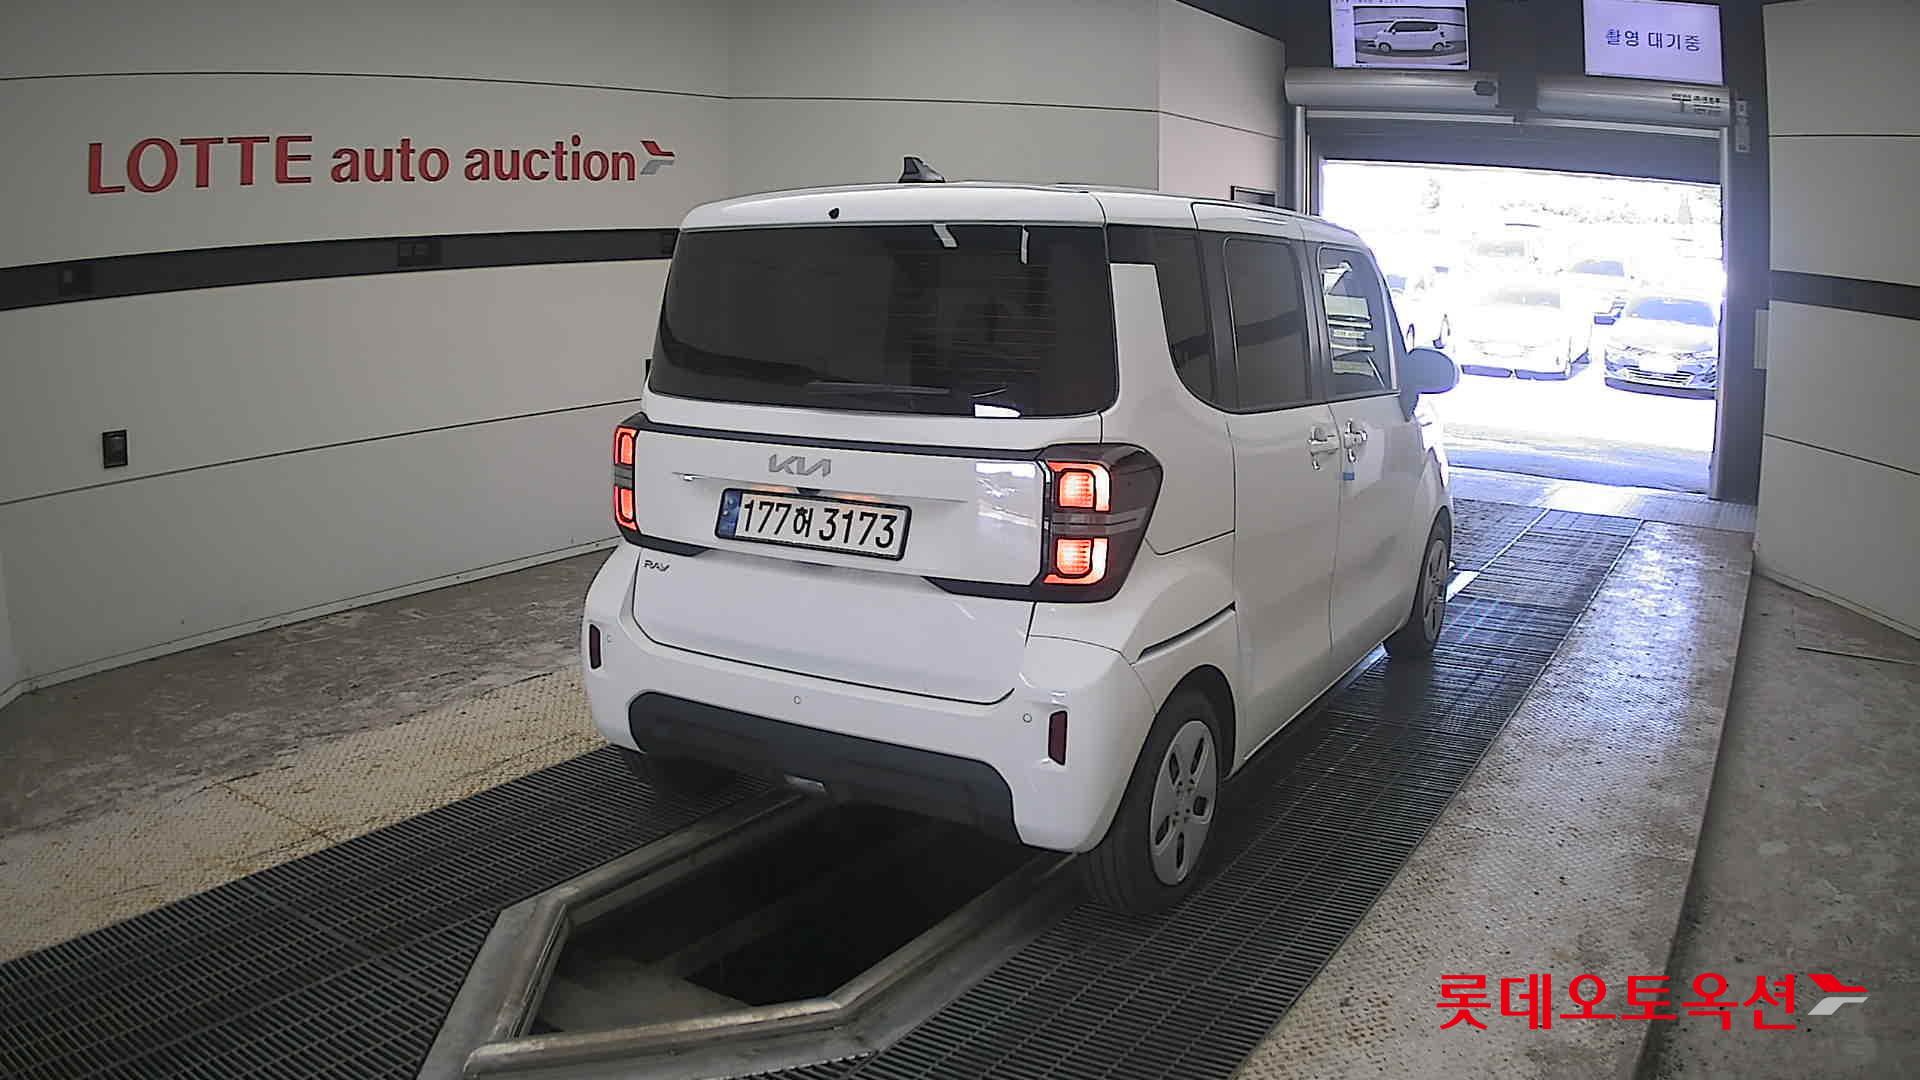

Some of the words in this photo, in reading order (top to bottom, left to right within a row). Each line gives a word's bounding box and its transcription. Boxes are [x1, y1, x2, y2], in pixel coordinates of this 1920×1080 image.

[1648, 31, 1701, 52] 대기중
[87, 134, 313, 195] LOTTE
[330, 137, 451, 183] auto
[463, 134, 637, 183] auction
[818, 506, 898, 549] 3173
[643, 558, 671, 573] RAY
